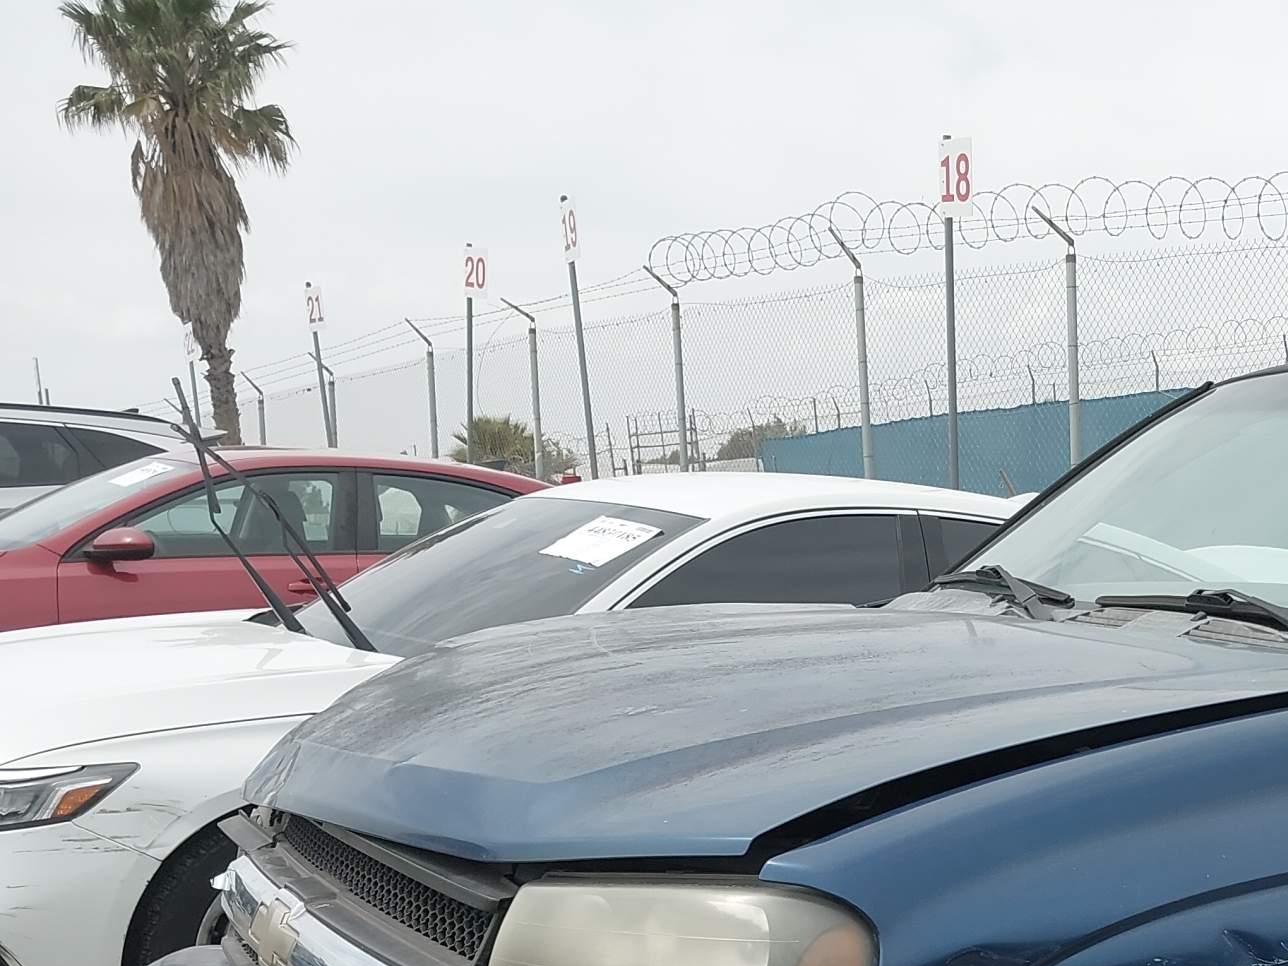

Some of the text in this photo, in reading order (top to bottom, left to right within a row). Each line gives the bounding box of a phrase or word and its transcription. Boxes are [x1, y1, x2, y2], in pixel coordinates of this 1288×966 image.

[940, 153, 970, 202] 18
[562, 209, 577, 251] 19
[465, 256, 486, 289] 20
[306, 296, 324, 323] 21
